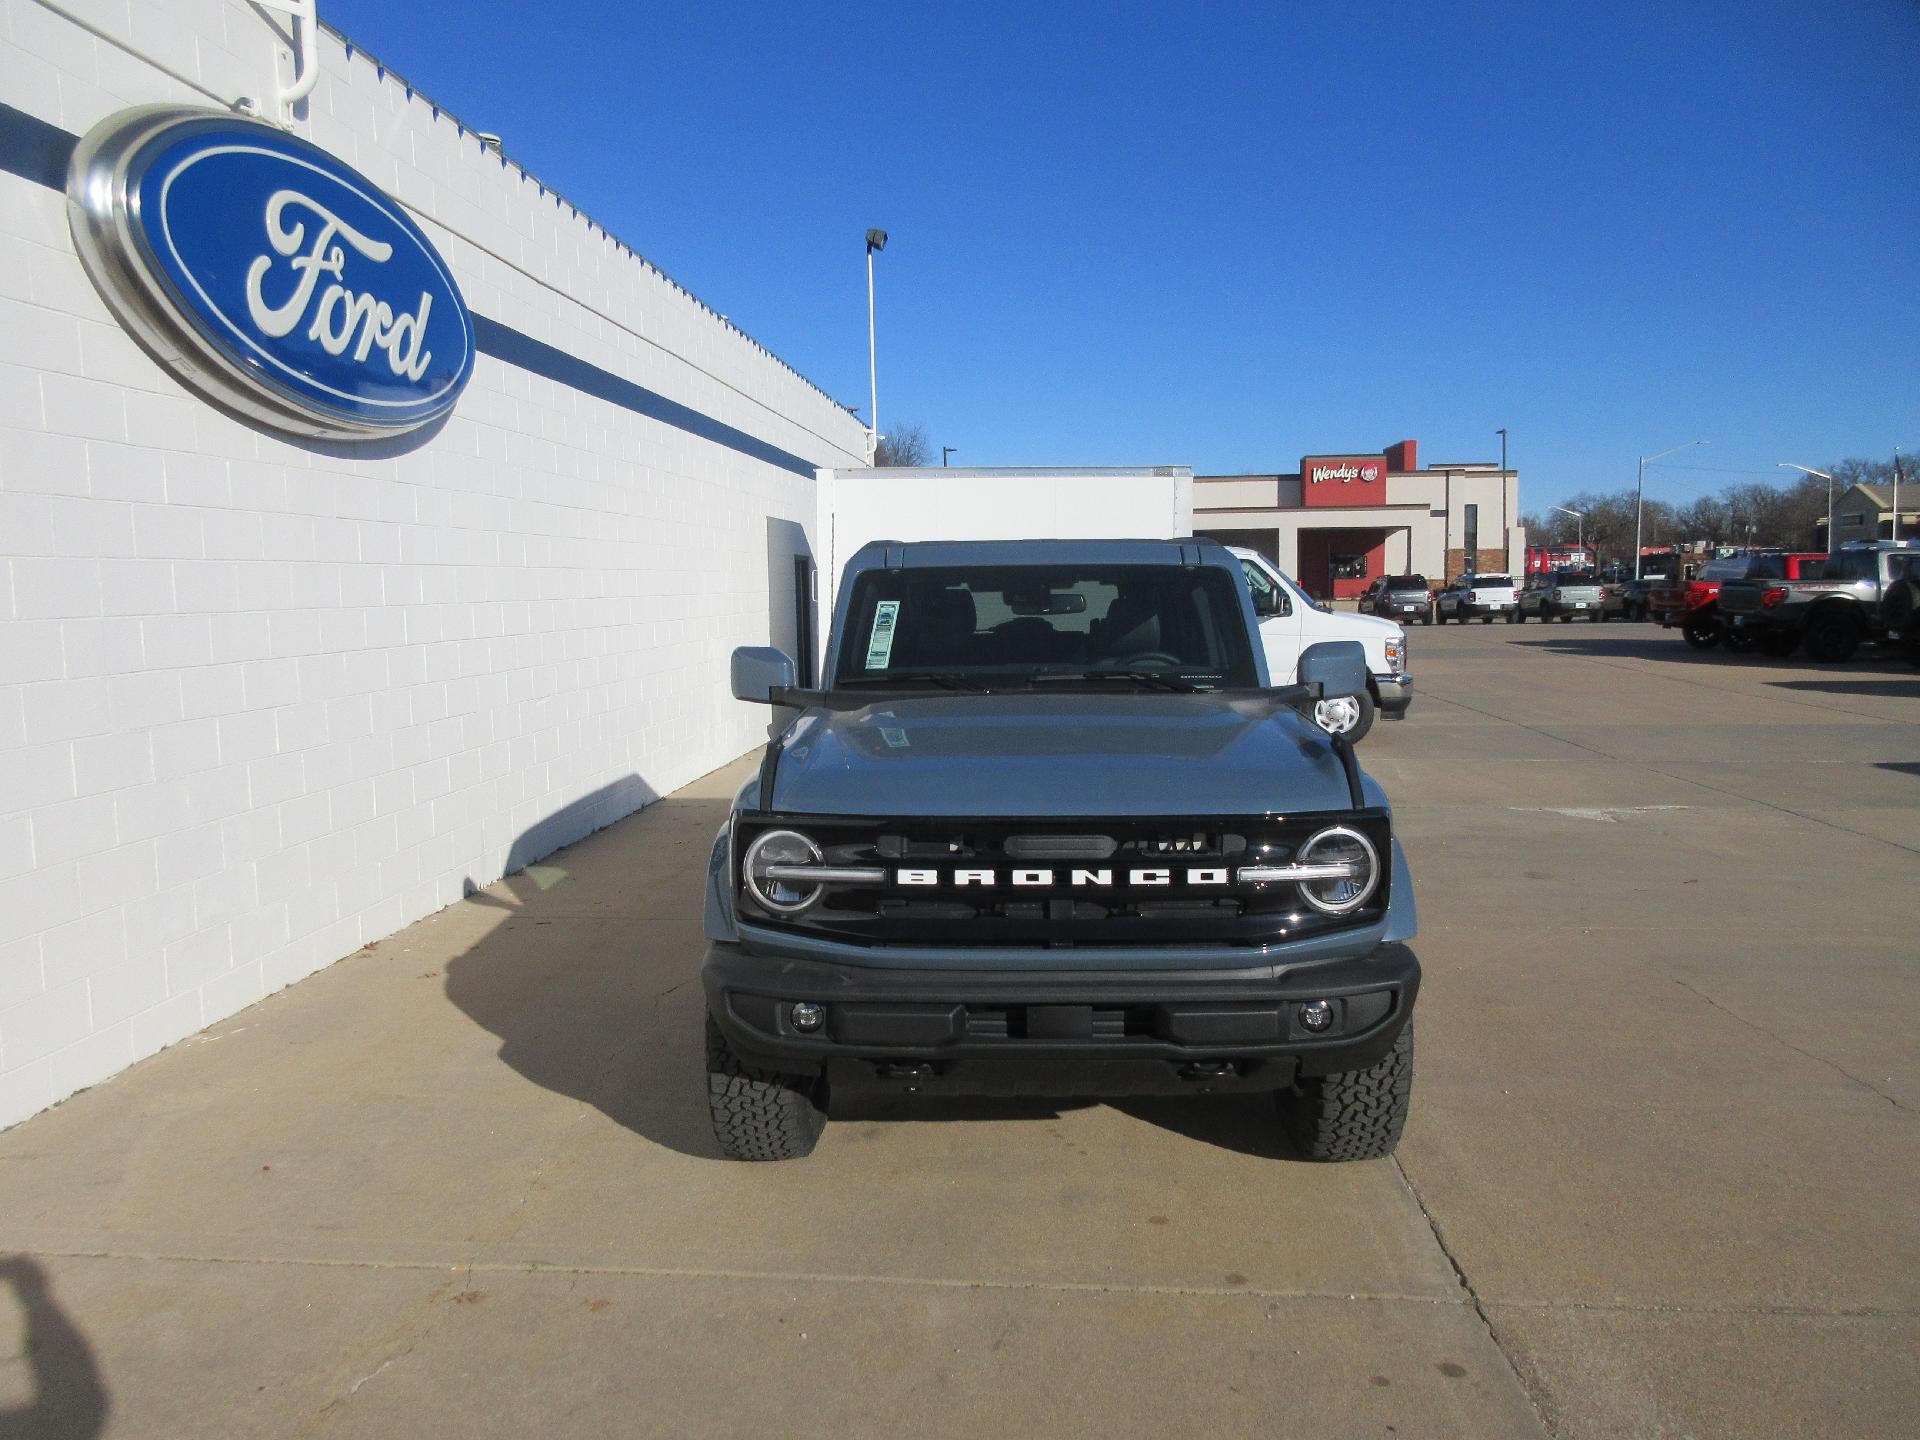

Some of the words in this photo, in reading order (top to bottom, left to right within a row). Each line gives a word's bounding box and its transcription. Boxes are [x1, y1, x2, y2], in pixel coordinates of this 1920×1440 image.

[246, 189, 433, 382] Ford
[1312, 463, 1358, 483] Wendy's
[897, 869, 1227, 885] BRONCO
